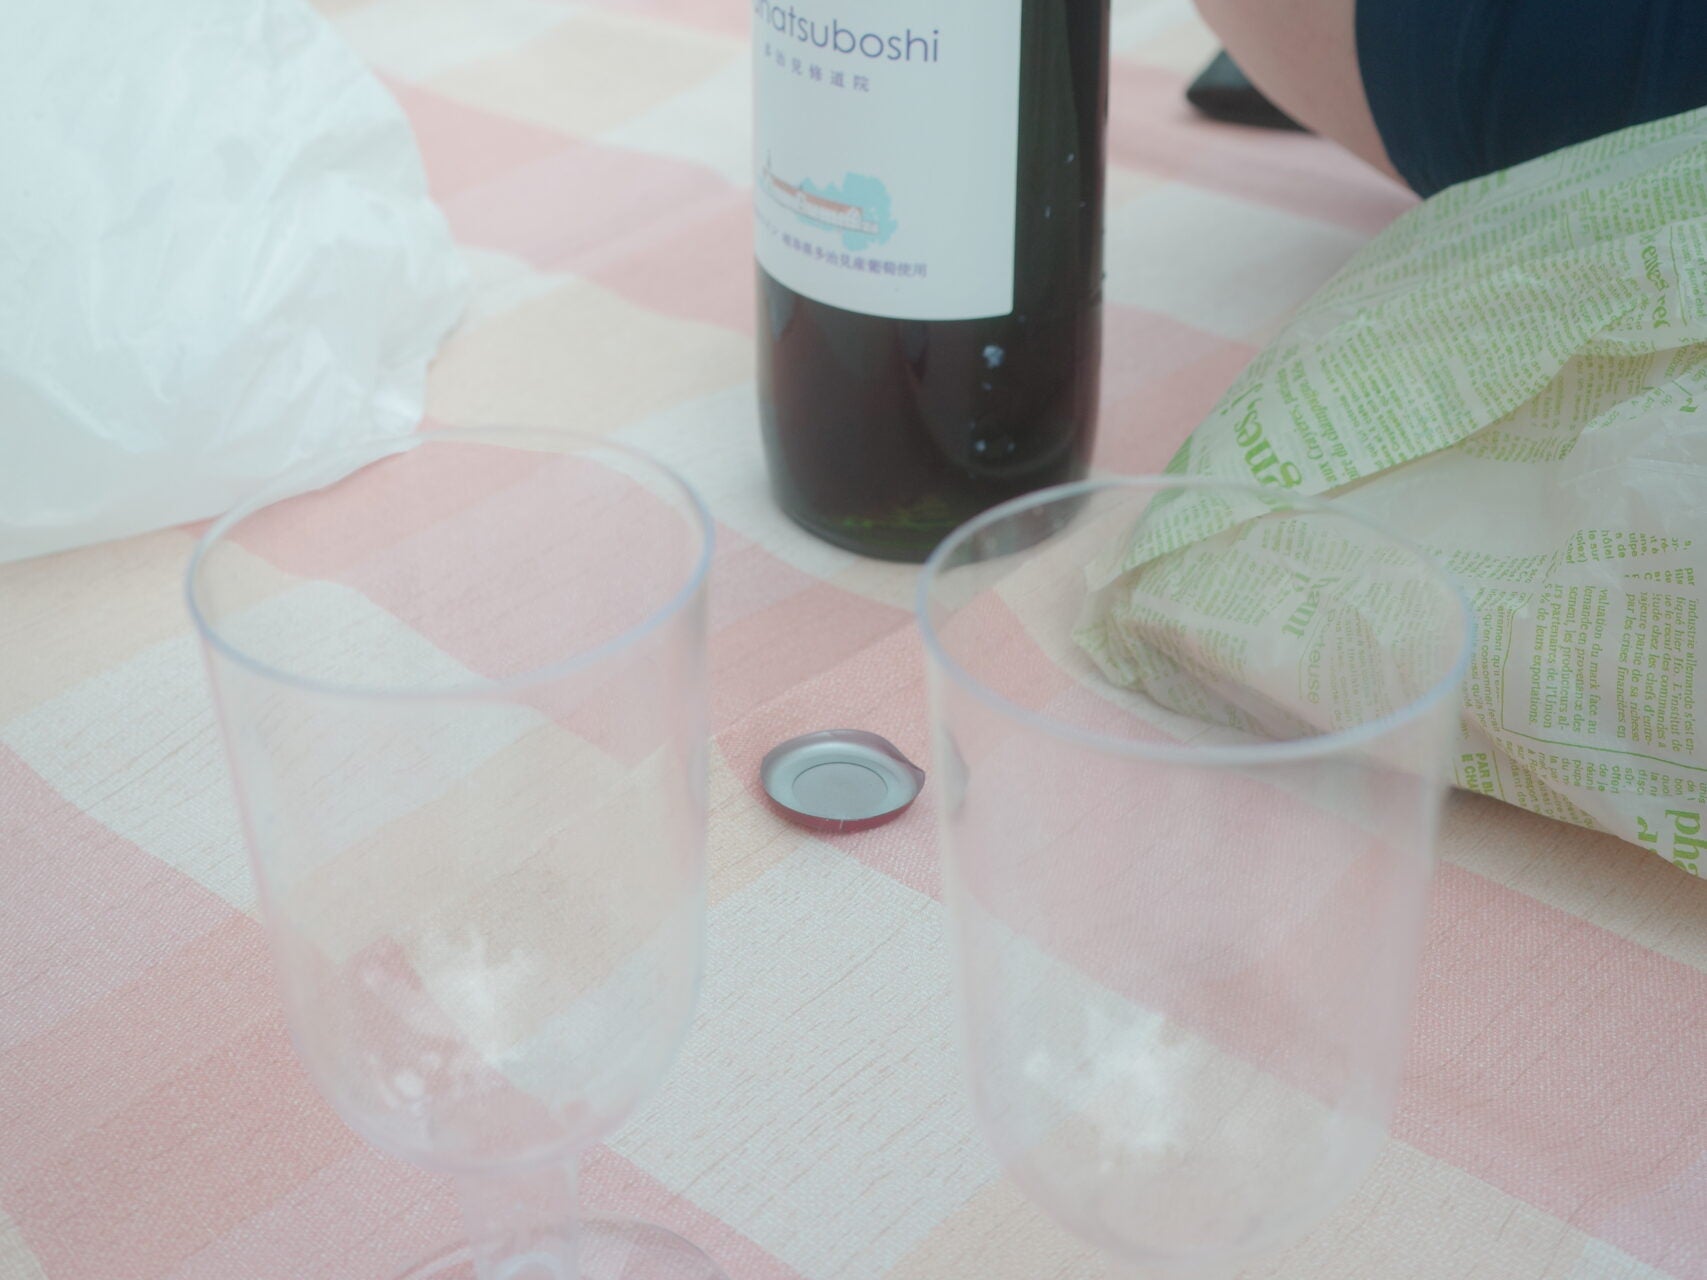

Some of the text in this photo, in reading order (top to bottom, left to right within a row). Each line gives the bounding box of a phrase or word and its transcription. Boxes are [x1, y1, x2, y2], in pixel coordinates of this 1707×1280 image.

[1624, 592, 1637, 614] par
[1536, 607, 1550, 622] de
[1623, 615, 1637, 631] les
[1534, 625, 1548, 651] leurs
[1546, 602, 1563, 664] partenaires
[1562, 629, 1577, 644] les
[1577, 631, 1588, 645] en
[1650, 624, 1662, 650] chez
[1589, 643, 1603, 658] du
[1618, 632, 1632, 663] crises
[1632, 632, 1646, 665] partie
[1647, 653, 1660, 669] les
[1546, 668, 1559, 681] de
[1558, 645, 1573, 713] producteurs
[1573, 647, 1587, 710] provenance
[1631, 668, 1643, 683] de
[1644, 672, 1658, 700] chefs
[1543, 685, 1559, 729] l'Union
[1589, 693, 1602, 717] face
[1656, 674, 1669, 739] commandes
[1572, 713, 1586, 733] des
[1587, 719, 1598, 735] au
[1616, 725, 1627, 739] en
